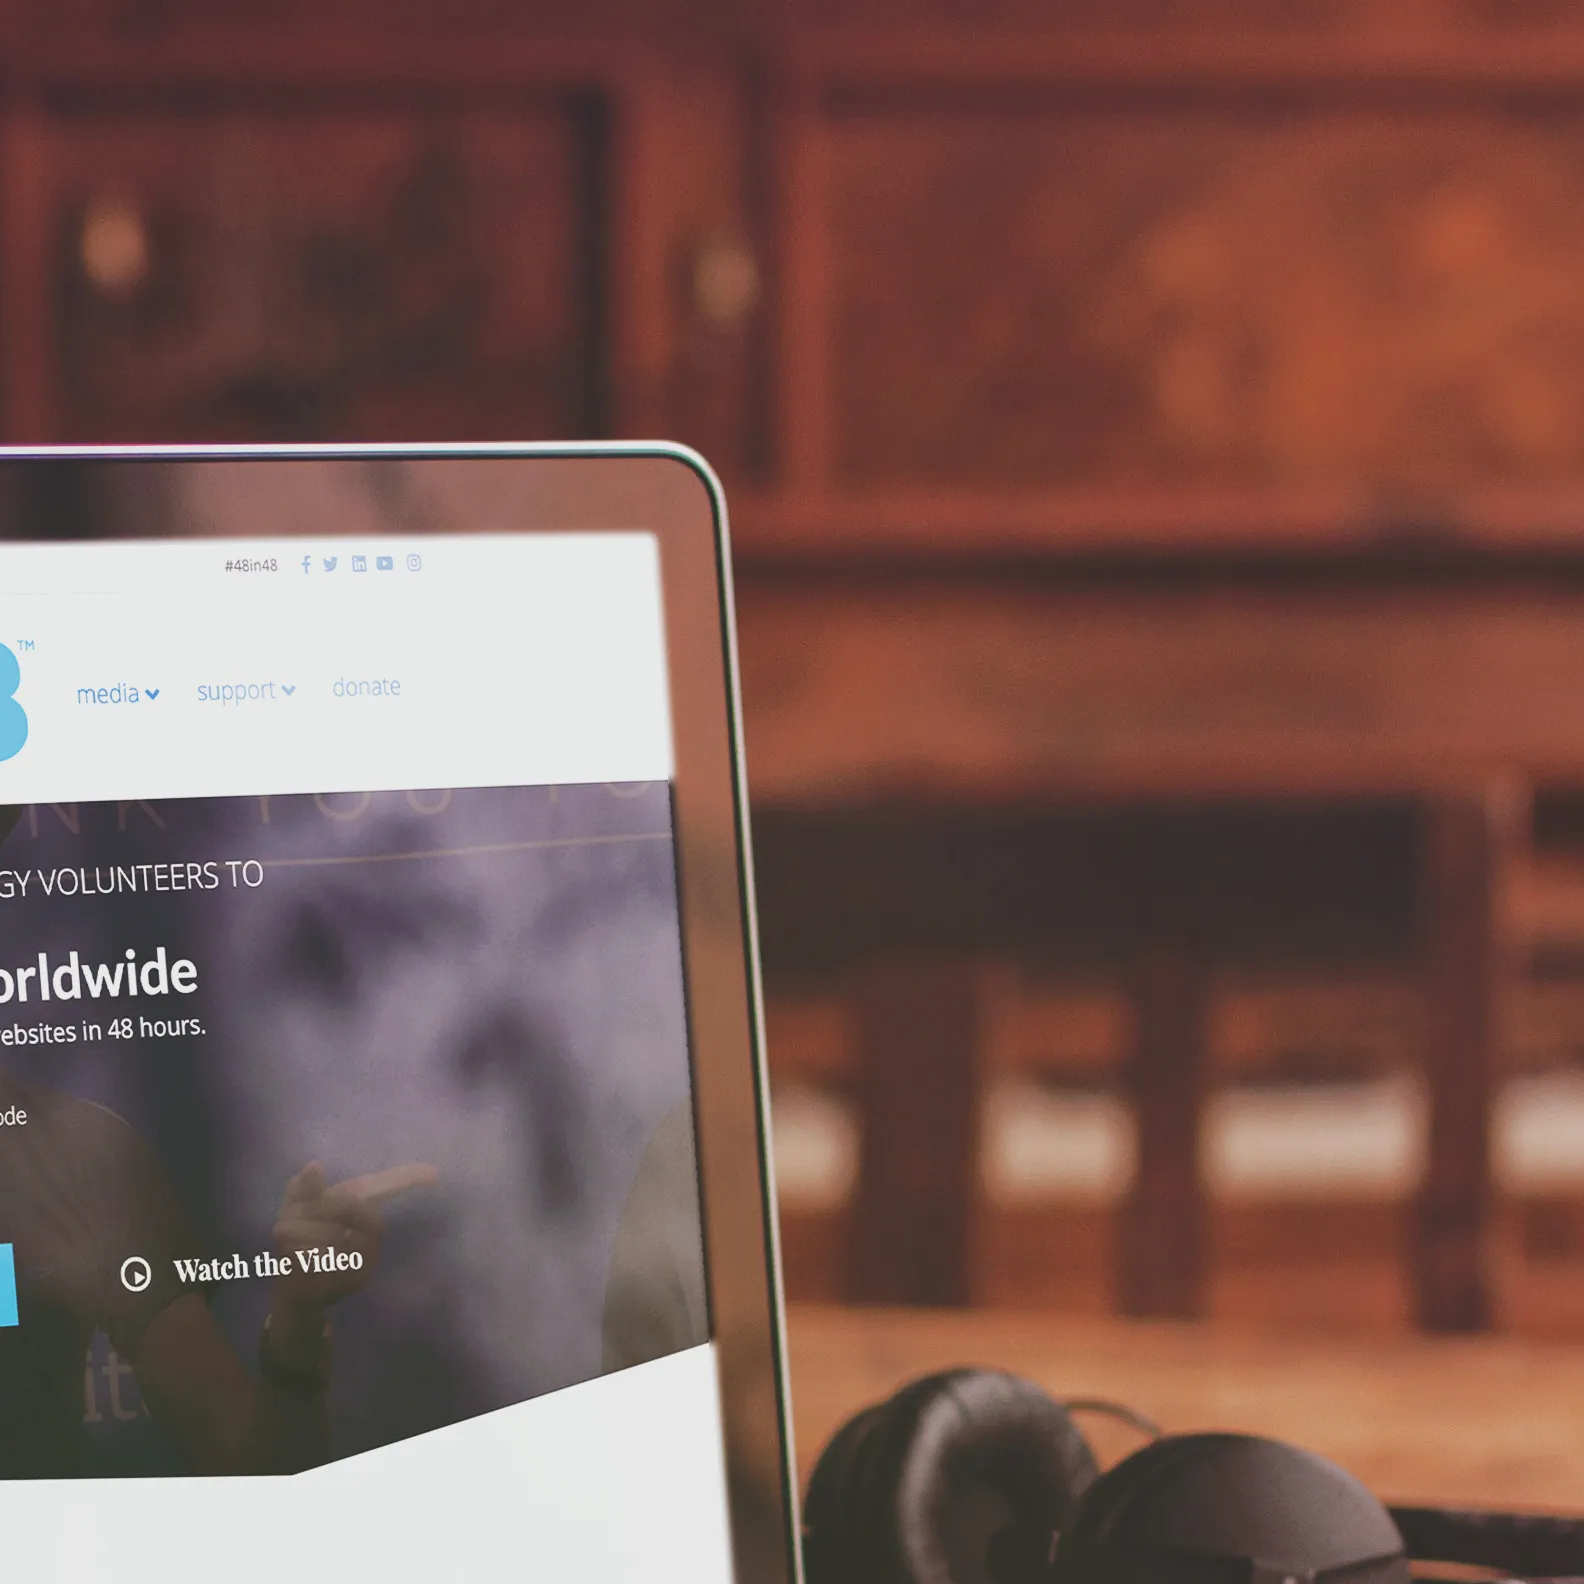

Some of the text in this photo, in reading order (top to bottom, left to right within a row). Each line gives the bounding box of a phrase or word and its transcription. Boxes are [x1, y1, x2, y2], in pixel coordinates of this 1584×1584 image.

[225, 559, 277, 572] #48in48
[78, 677, 400, 706] media support donate
[38, 862, 219, 895] VOLUNTEERS
[225, 860, 263, 887] TO
[83, 1021, 101, 1041] in
[108, 1018, 133, 1039] 48
[140, 1017, 205, 1037] hours.
[173, 1247, 363, 1282] Watch the Video
